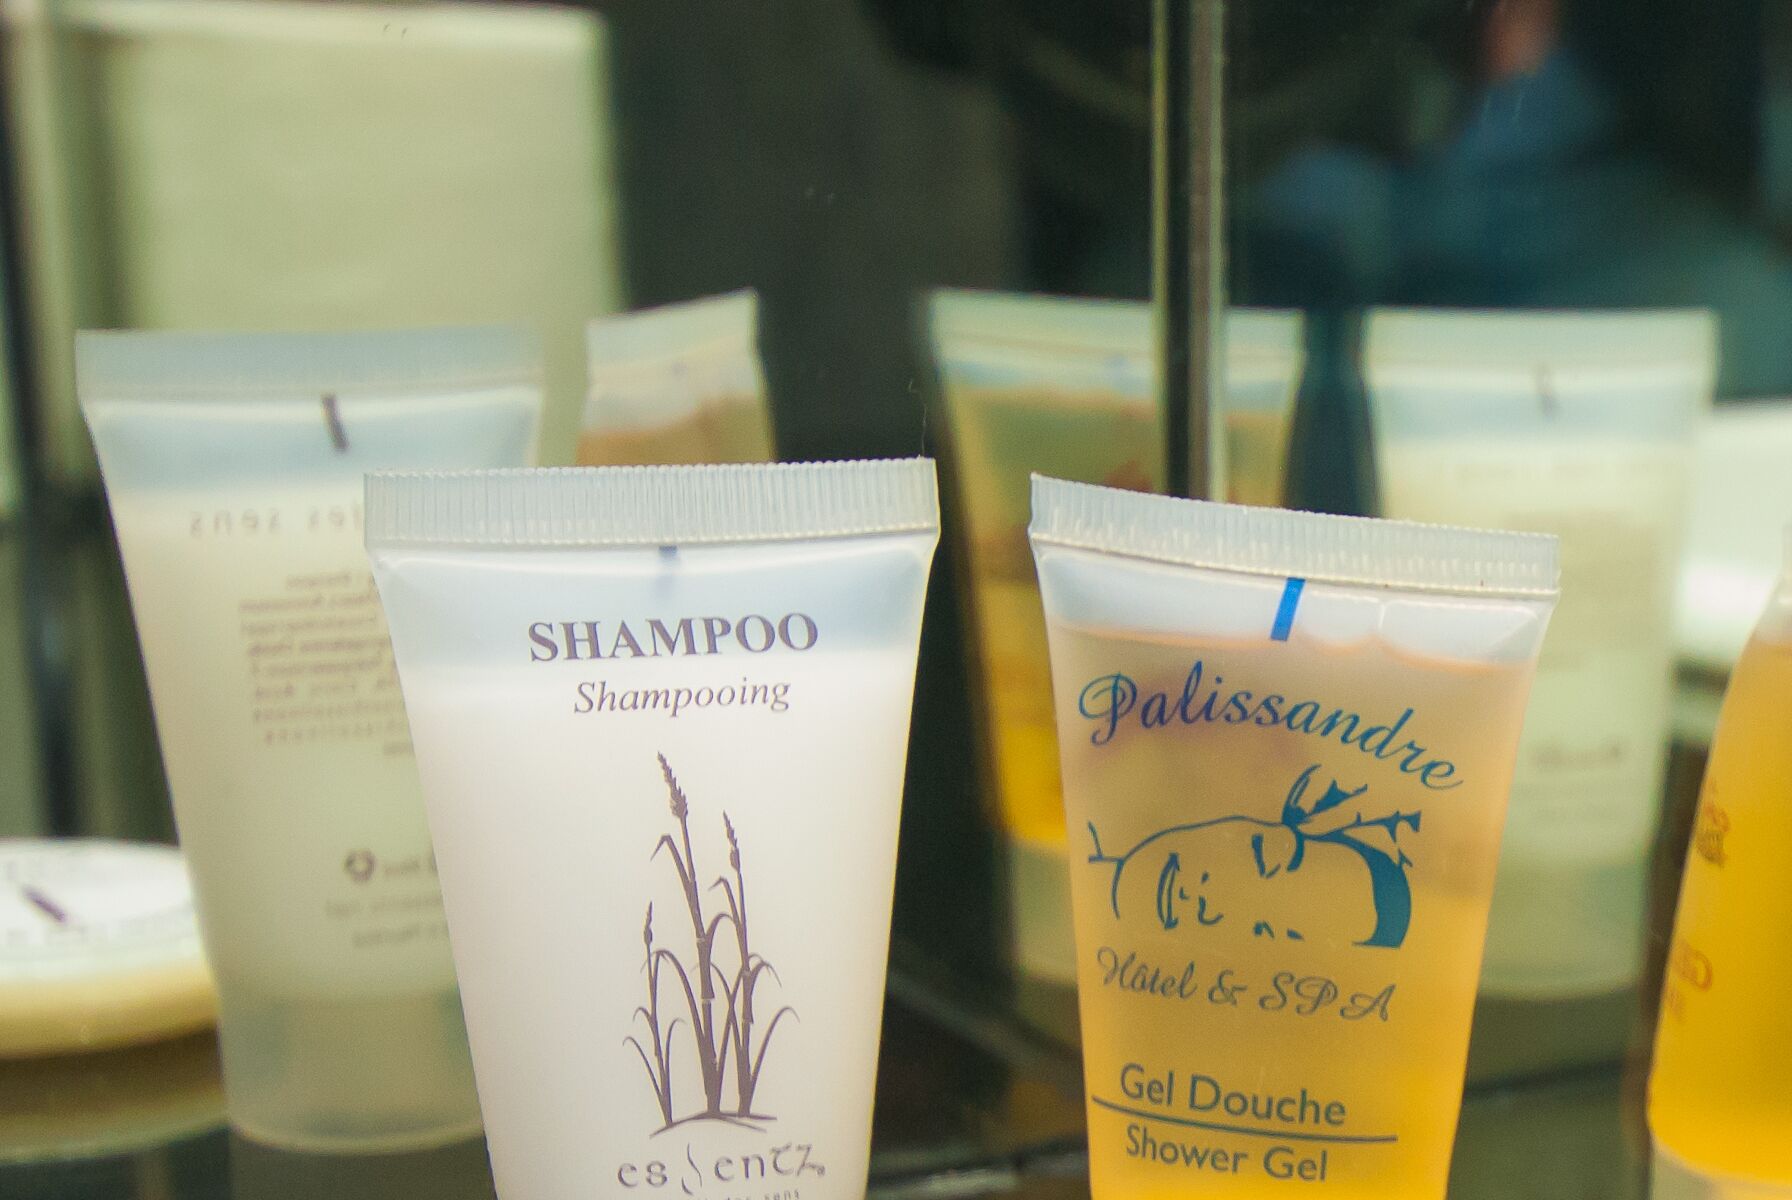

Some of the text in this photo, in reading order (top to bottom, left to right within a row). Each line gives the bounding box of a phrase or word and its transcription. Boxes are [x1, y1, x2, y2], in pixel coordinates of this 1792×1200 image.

[528, 612, 819, 662] SHAMPOO
[574, 676, 791, 718] Shampooing
[1078, 660, 1463, 790] Palissandre
[1097, 946, 1397, 1022] Hôtel & SPA
[1120, 1062, 1347, 1127] Gel Douche
[1125, 1123, 1328, 1182] Shower Gel
